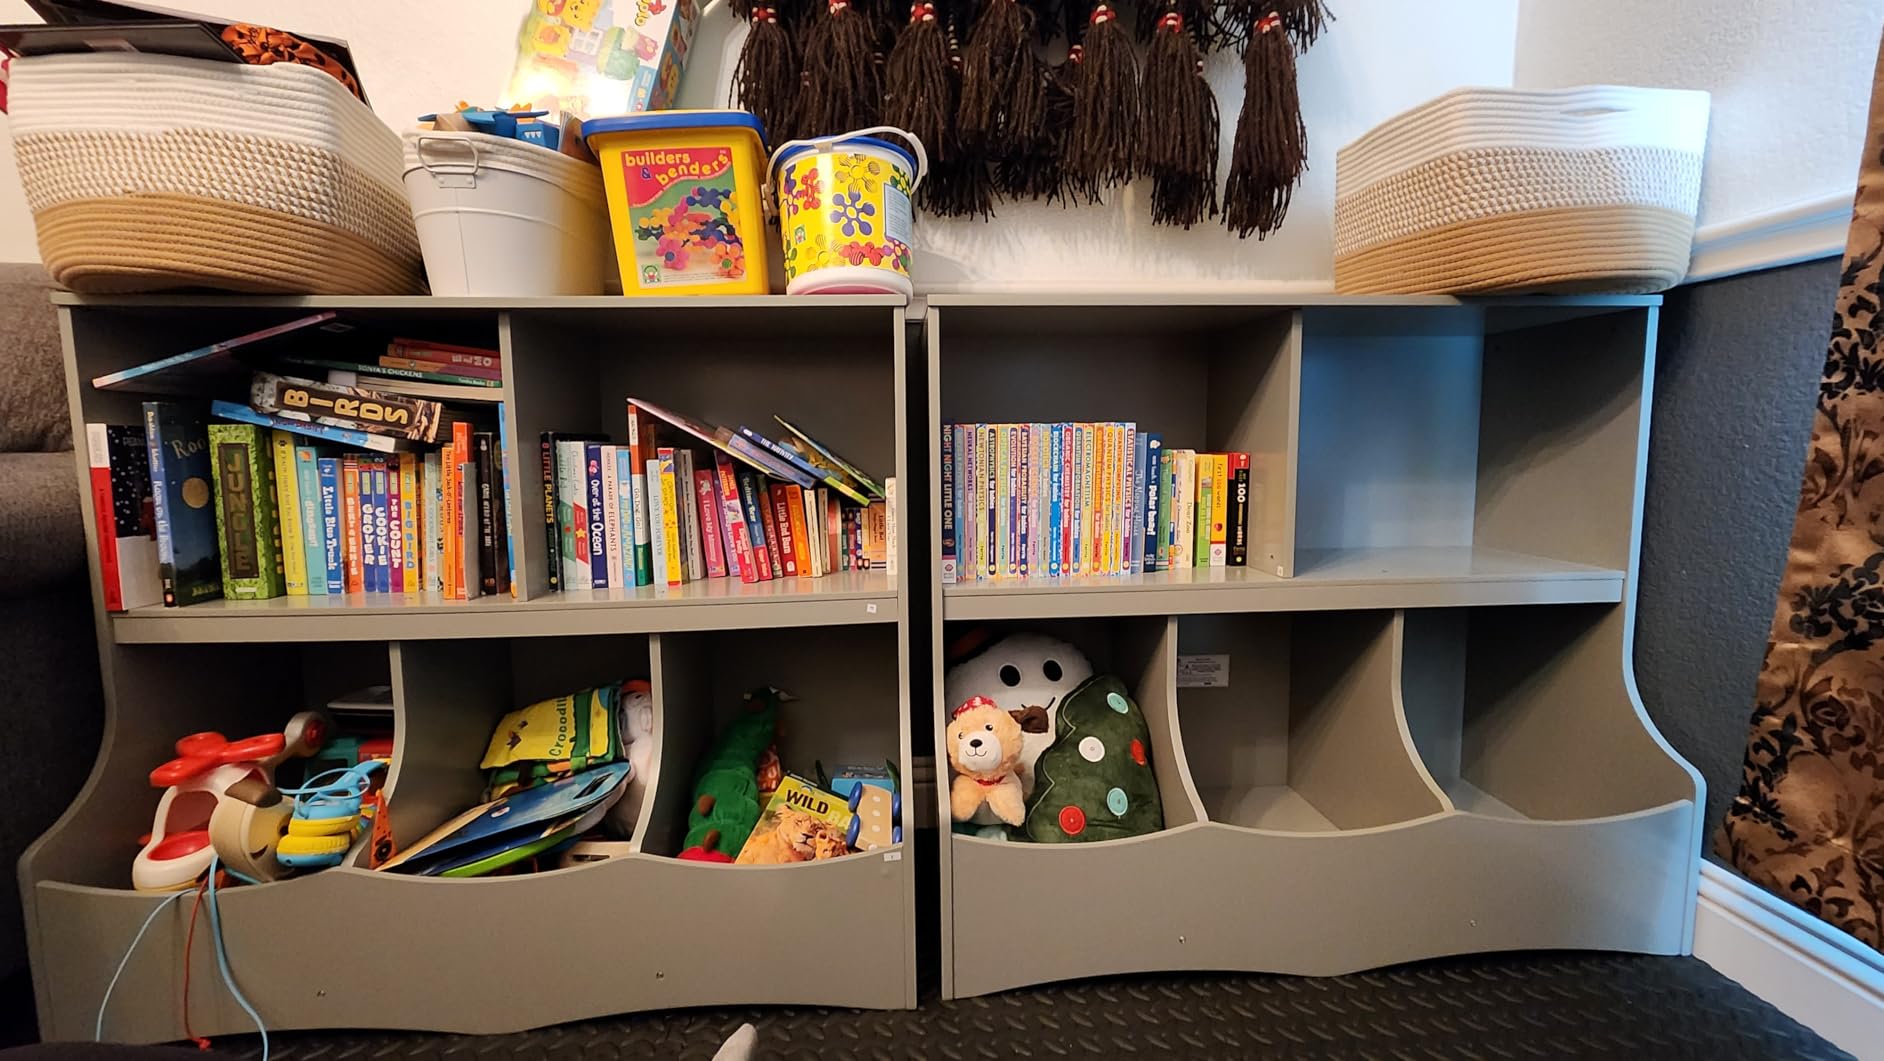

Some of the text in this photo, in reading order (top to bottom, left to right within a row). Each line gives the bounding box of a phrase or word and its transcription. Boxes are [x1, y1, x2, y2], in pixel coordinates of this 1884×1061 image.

[625, 152, 690, 166] builders
[642, 154, 728, 185] & benders
[452, 355, 492, 366] ELMO
[284, 388, 408, 424] BIRDS
[760, 438, 772, 448] THE
[543, 452, 551, 480] LITTLE
[944, 424, 952, 530] NIGHT NIGHT LITTLE ONE
[1134, 469, 1142, 486] The
[153, 480, 163, 506] Room
[544, 483, 554, 524] PLANETS
[591, 479, 600, 497] Over
[1237, 483, 1246, 503] 100
[227, 453, 251, 570] JUNGLE
[594, 508, 602, 520] the
[748, 506, 756, 522] Bear
[1146, 484, 1158, 536] polar bear!
[322, 486, 338, 570] Little Blue Truck
[362, 504, 374, 565] GROVER
[375, 507, 388, 566] COOKIE
[404, 502, 415, 568] BIG BIRD
[592, 522, 604, 555] Ocean
[706, 522, 714, 533] My
[776, 502, 792, 554] Little Red Barn
[390, 520, 402, 568] COUNT
[786, 790, 829, 814] WILD
